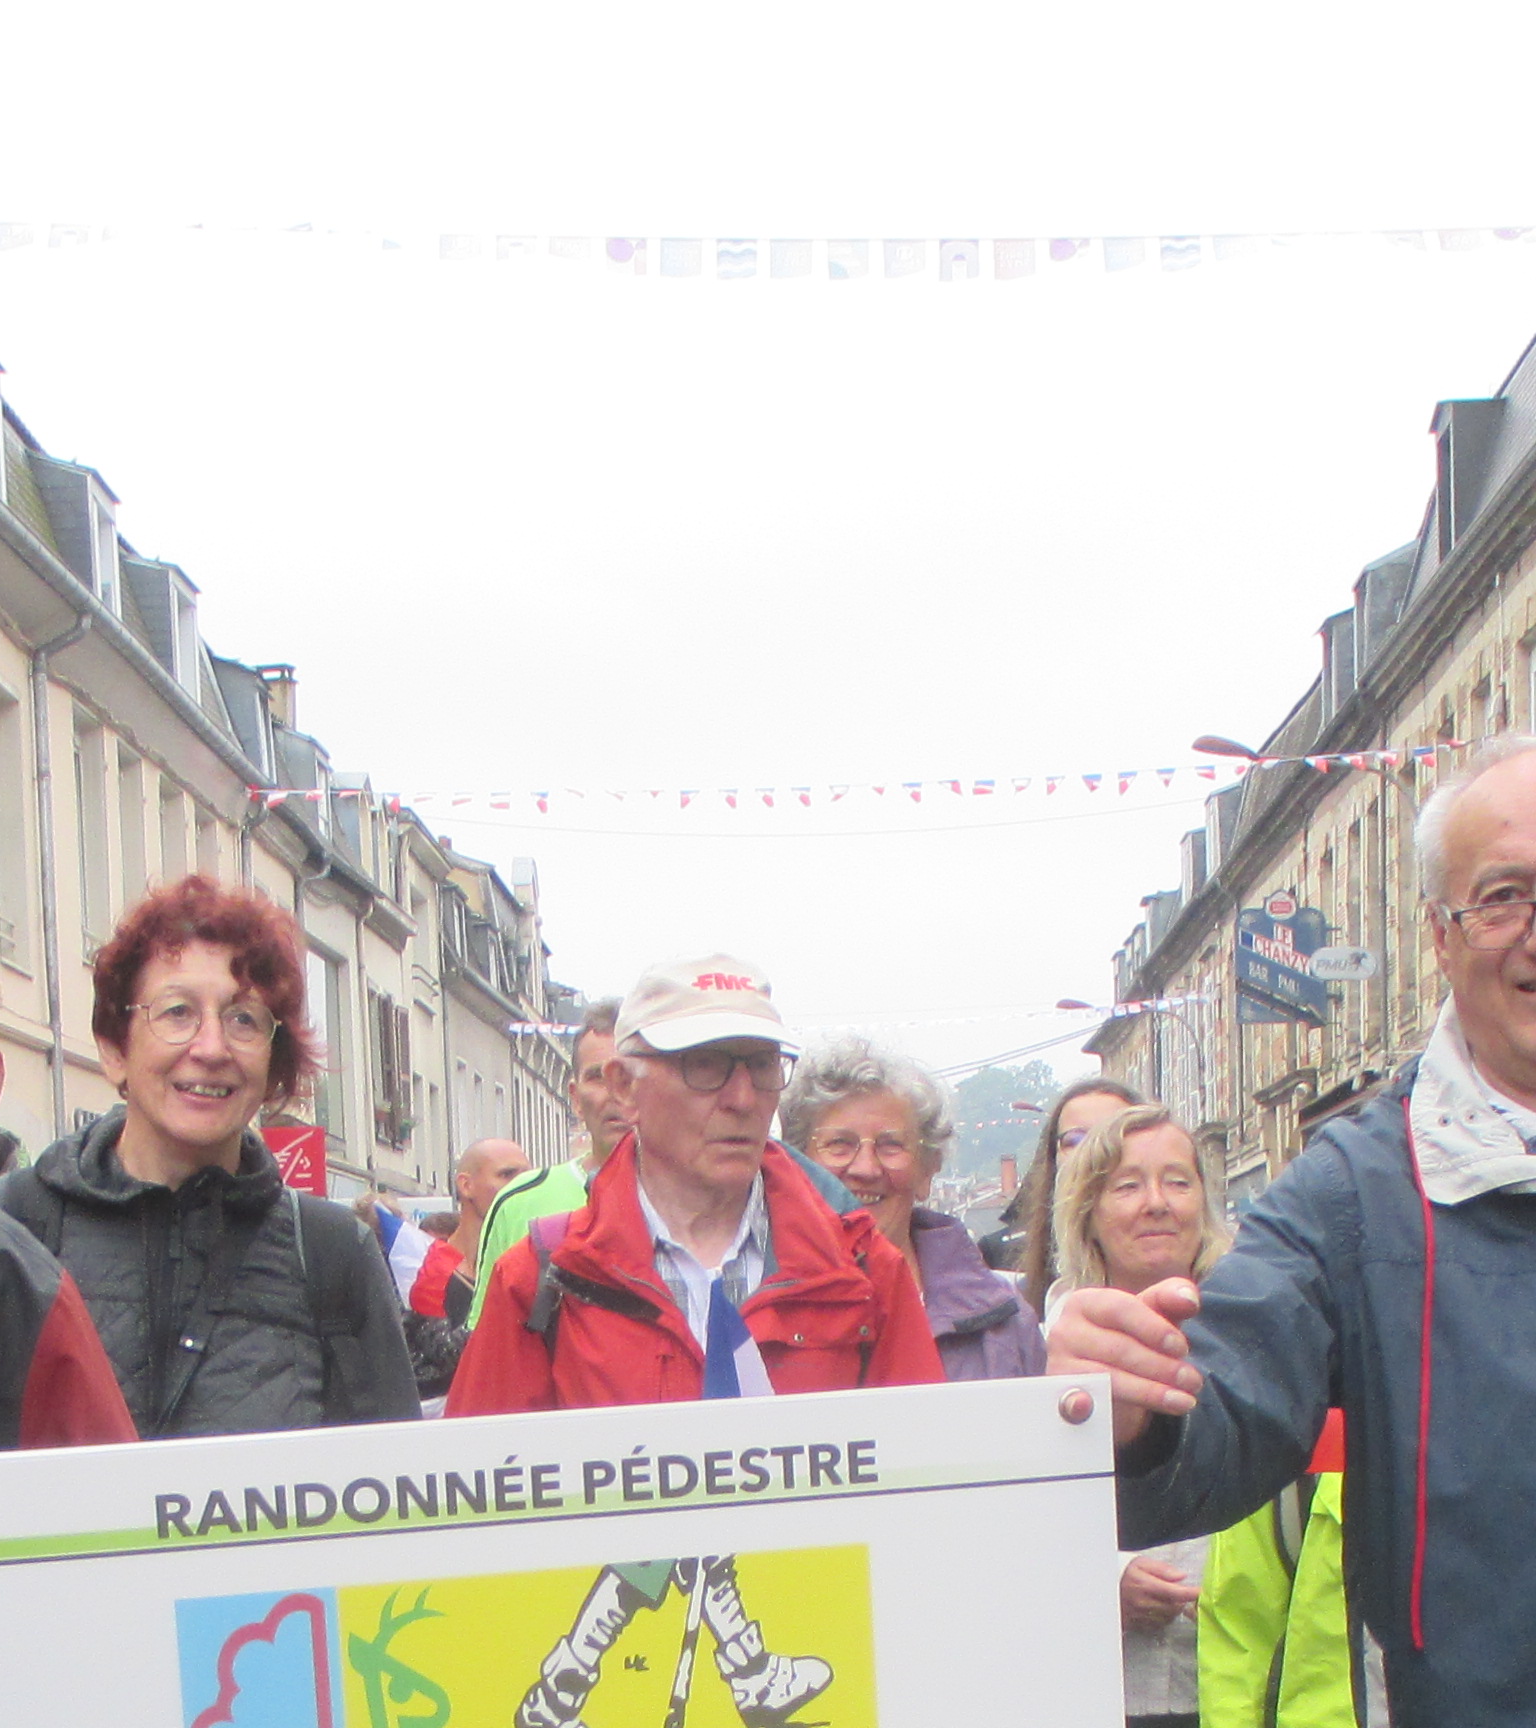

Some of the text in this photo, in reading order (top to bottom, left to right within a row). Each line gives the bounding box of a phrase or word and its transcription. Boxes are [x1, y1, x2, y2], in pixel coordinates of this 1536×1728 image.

[1273, 923, 1294, 948] LE
[1254, 936, 1312, 977] CHANZY
[1315, 957, 1351, 971] PMU
[1248, 960, 1269, 983] BAR
[156, 1439, 880, 1540] RANDONNÉE PÉDESTRE
